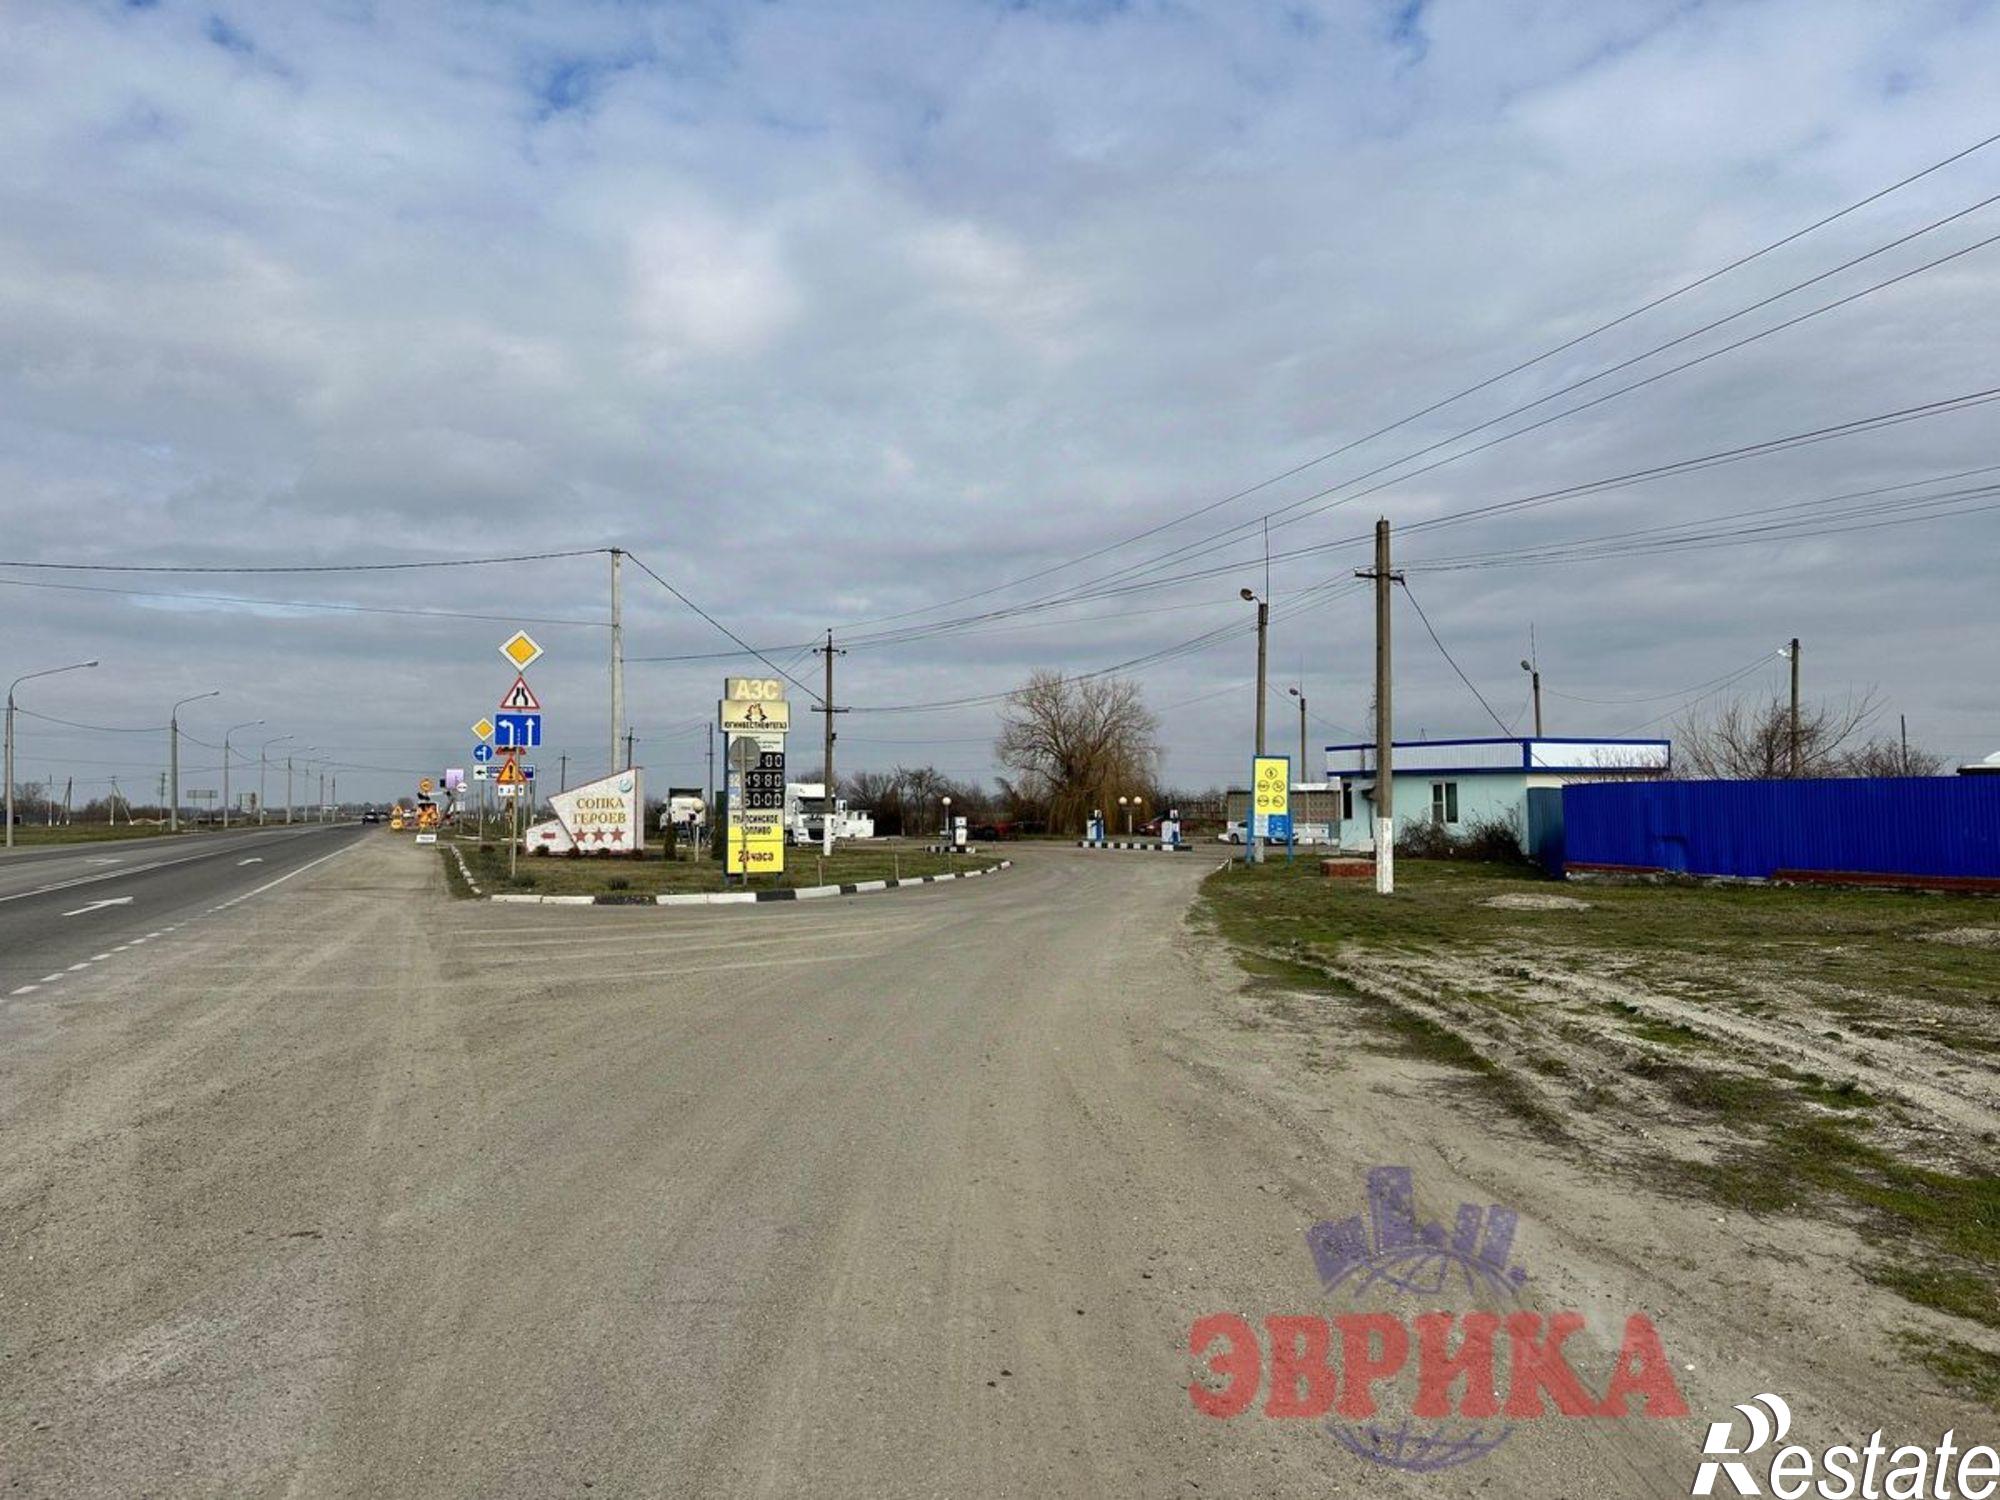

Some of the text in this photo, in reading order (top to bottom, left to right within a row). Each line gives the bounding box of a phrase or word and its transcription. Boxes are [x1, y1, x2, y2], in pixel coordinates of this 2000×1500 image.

[734, 680, 779, 700] АЗС
[576, 798, 624, 809] СОПКА
[573, 812, 626, 824] ГЕРОЕВ
[750, 852, 774, 862] часа
